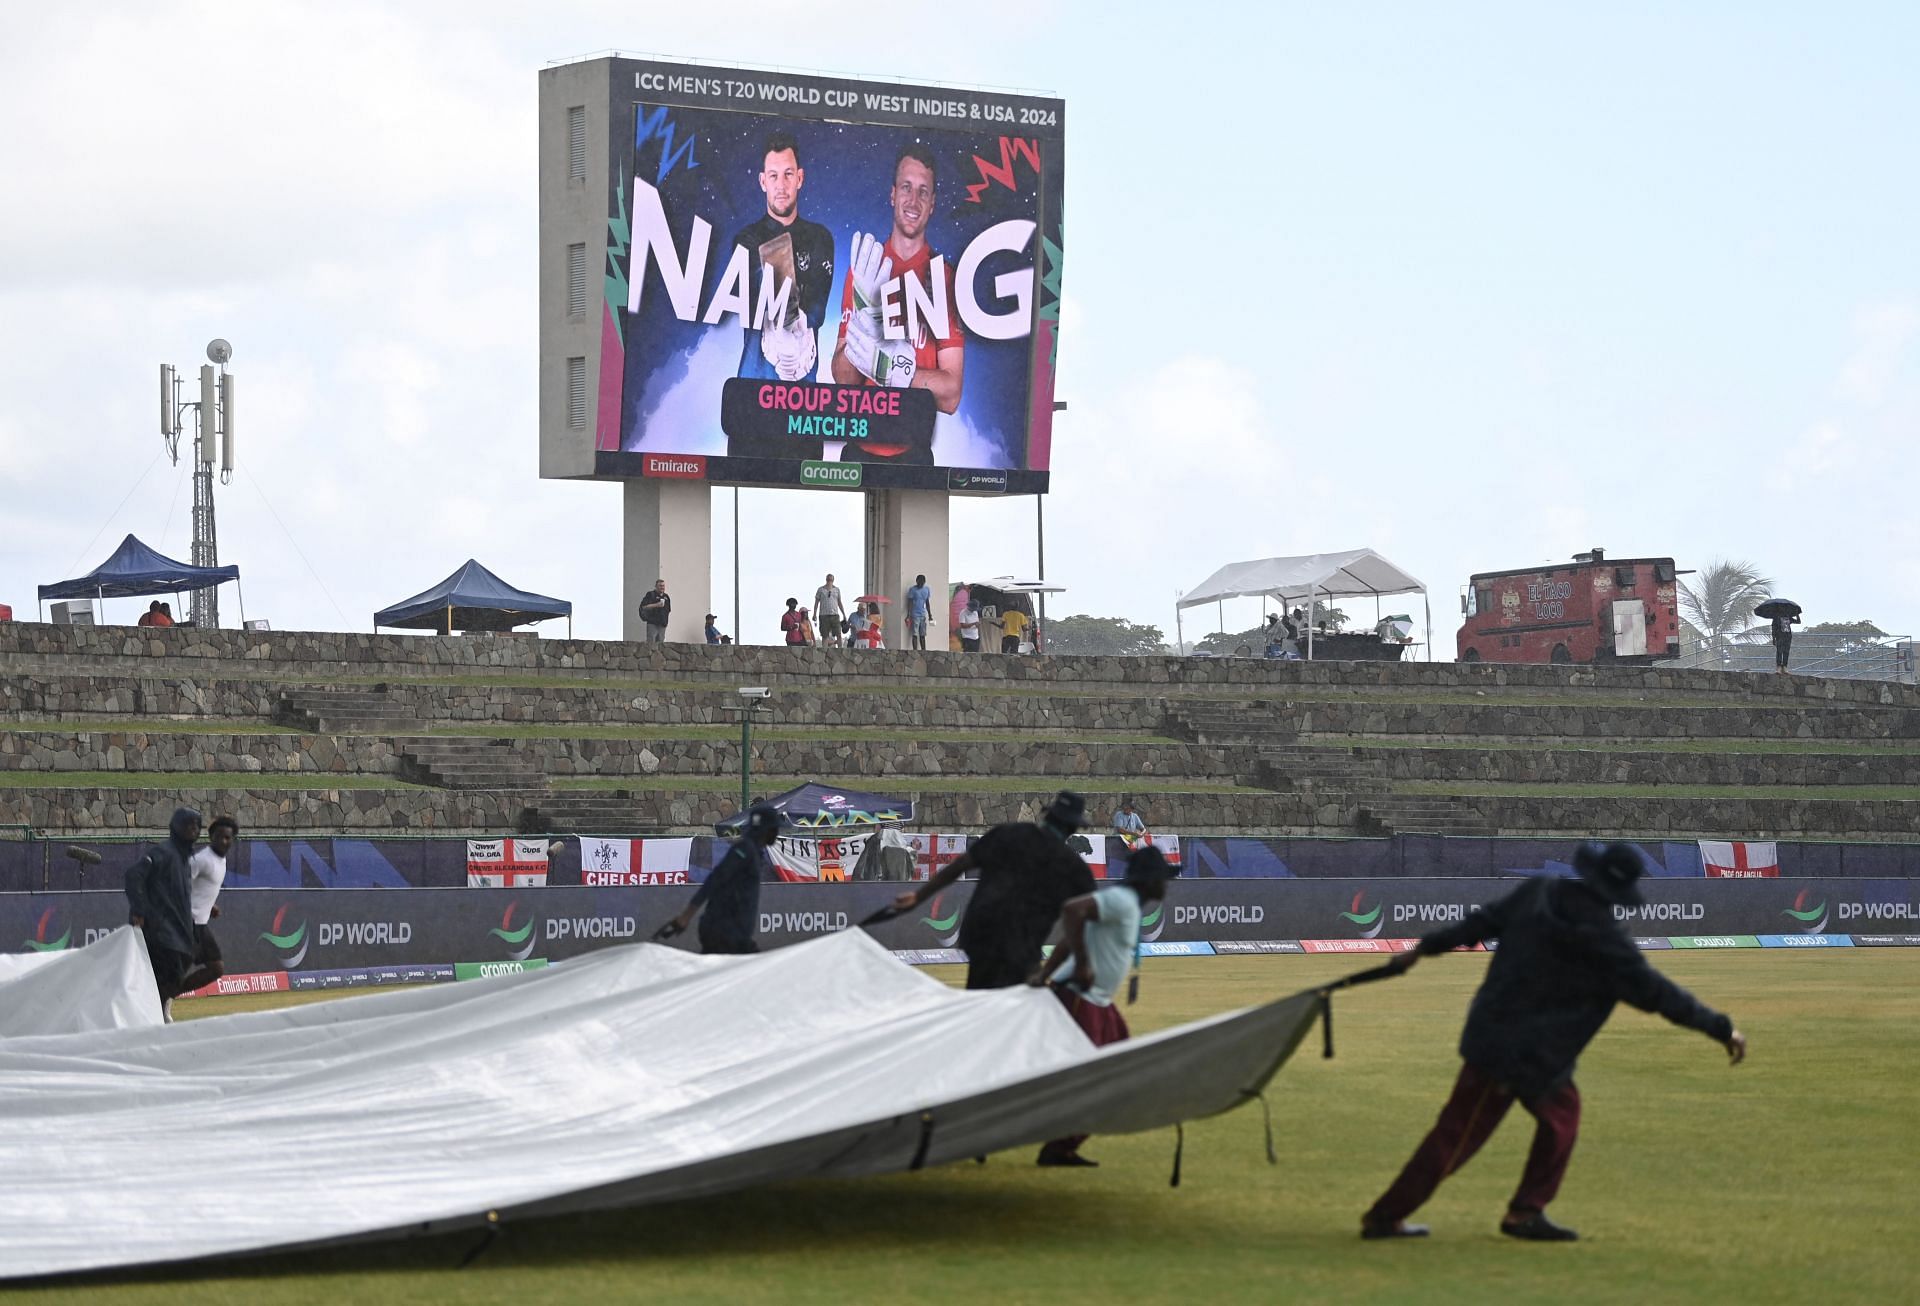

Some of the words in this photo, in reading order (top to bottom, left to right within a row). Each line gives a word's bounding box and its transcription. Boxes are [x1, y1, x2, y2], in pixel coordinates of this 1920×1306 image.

[635, 72, 665, 91] ICC
[668, 75, 721, 96] MEN'S
[725, 81, 755, 99] T20
[758, 83, 820, 105] WORLD
[825, 90, 858, 108] CUP
[864, 93, 909, 113] WEST
[914, 98, 966, 119] INDIES
[970, 104, 981, 119] &
[984, 105, 1015, 123] USA
[1020, 108, 1056, 126] 2024
[628, 176, 792, 331] NAM
[880, 219, 1037, 340] ENG
[758, 384, 832, 411] GROUP
[836, 390, 901, 416] STAGE
[788, 415, 846, 436] MATCH
[849, 418, 868, 437] 38
[650, 459, 698, 473] Emirates
[804, 465, 859, 481] aramco
[982, 476, 1005, 484] WORLD
[1528, 584, 1541, 601] EL
[1543, 581, 1572, 600] TACO
[1536, 602, 1564, 620] LOCO
[600, 863, 612, 871] CFC
[586, 872, 658, 885] CHELSEA
[664, 872, 685, 885] FC
[1174, 906, 1197, 924] DP
[1200, 905, 1264, 923] WORLD
[1393, 904, 1417, 921] DP
[1640, 904, 1704, 920] WORLD
[1838, 903, 1862, 919] DP
[1865, 903, 1920, 919] WORL
[546, 919, 570, 939] DP
[572, 917, 636, 938] WORLD
[760, 912, 782, 933] DP
[785, 912, 848, 932] WORLD
[320, 923, 343, 945] DP
[346, 922, 412, 944] WORLD
[217, 977, 250, 993] Emirates
